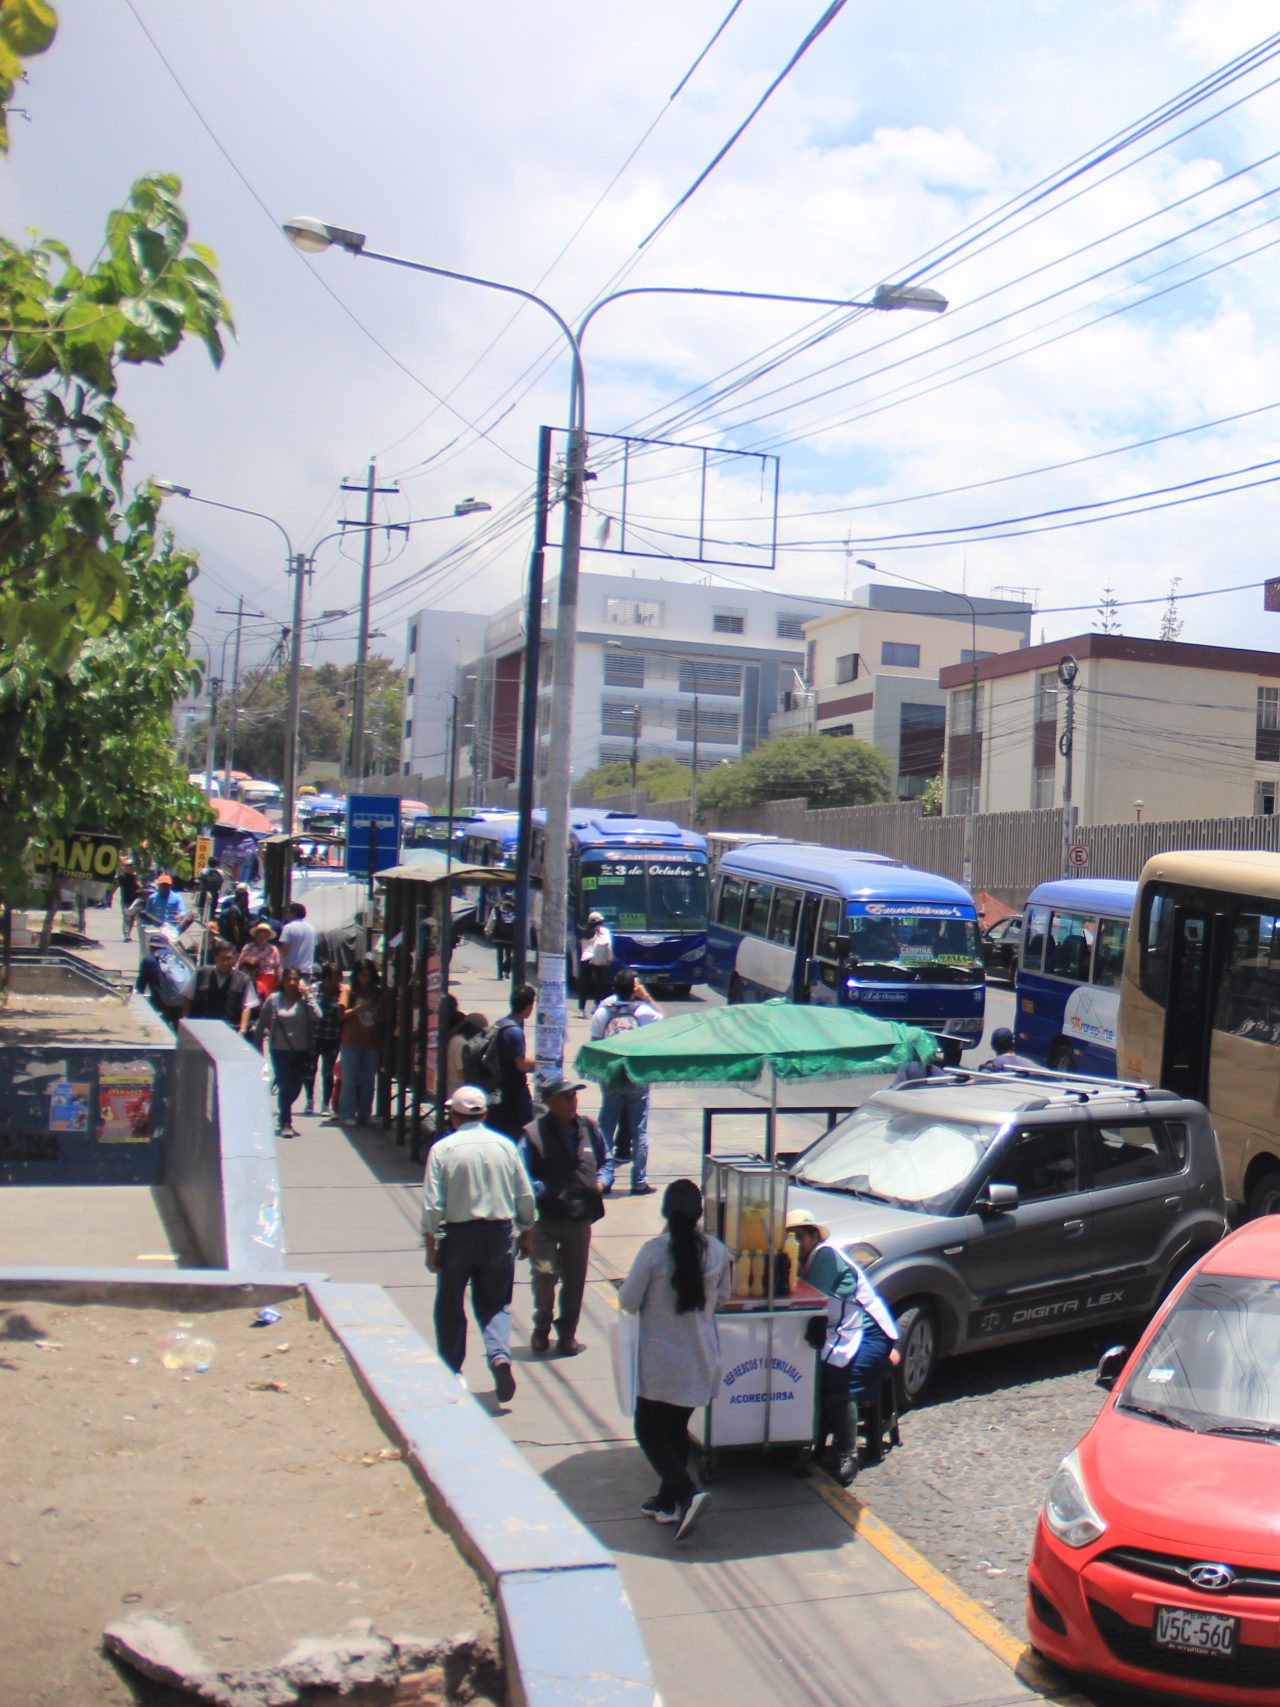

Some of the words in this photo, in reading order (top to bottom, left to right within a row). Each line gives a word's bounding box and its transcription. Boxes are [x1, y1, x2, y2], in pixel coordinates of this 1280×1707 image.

[1012, 1300, 1079, 1323] DIGITA
[1086, 1290, 1125, 1308] LEX
[1160, 1615, 1233, 1650] V5C-560
